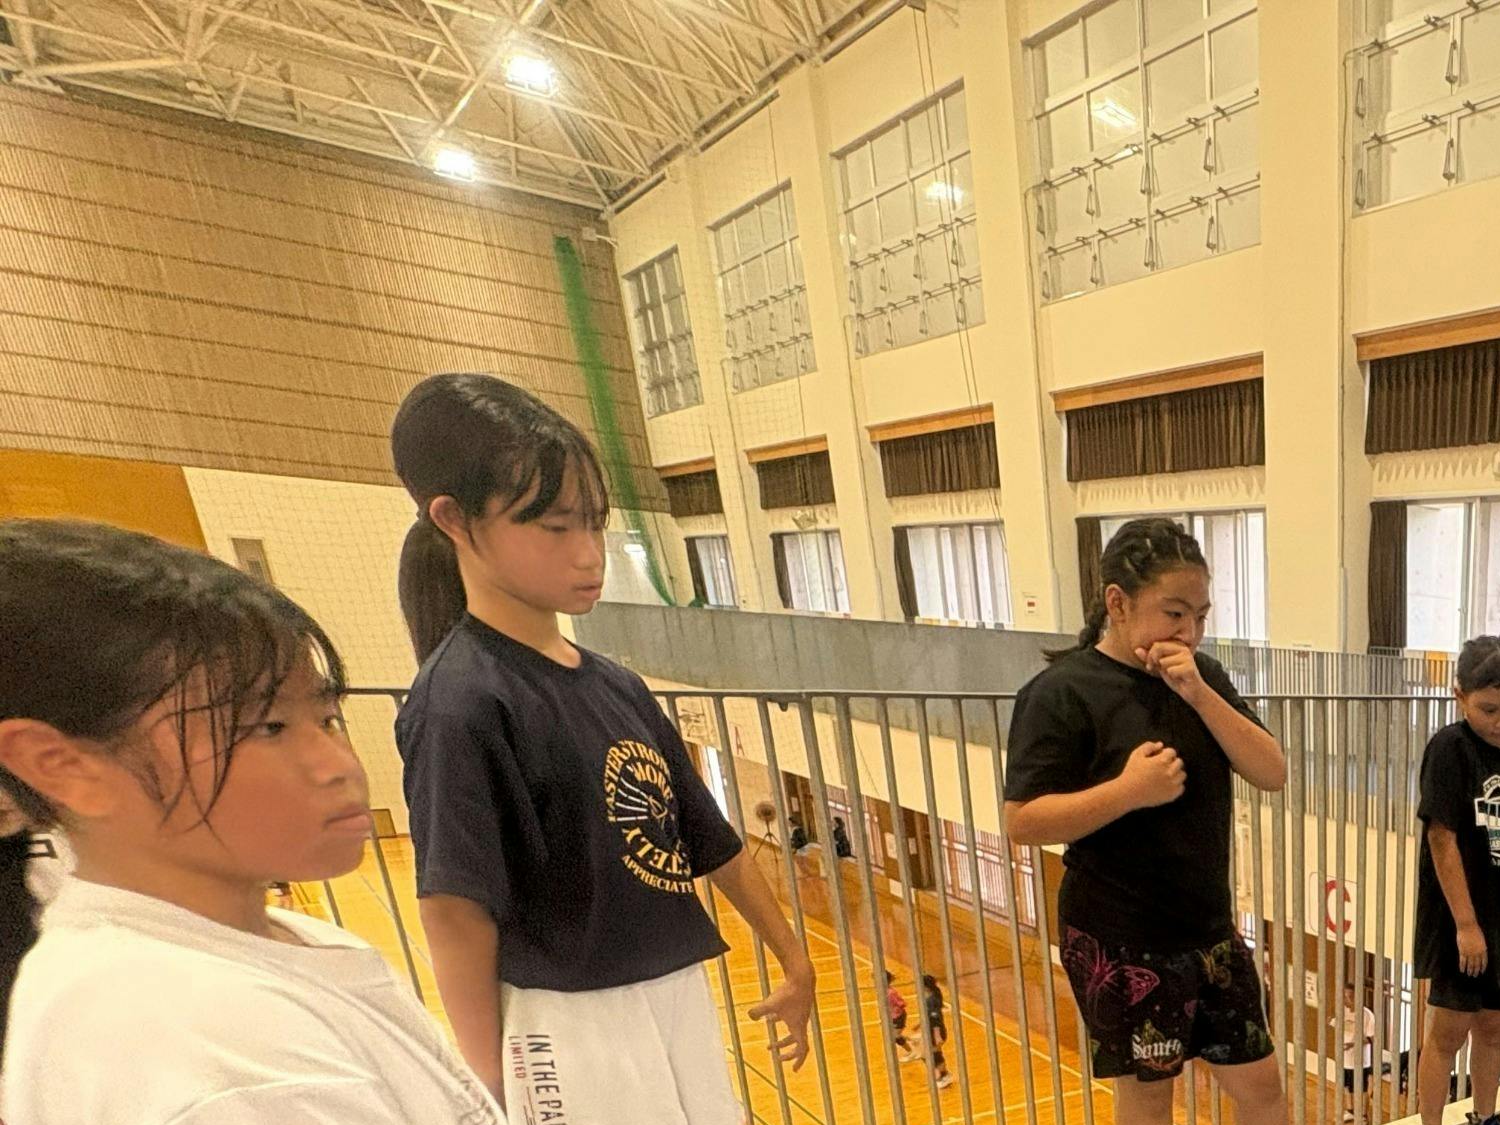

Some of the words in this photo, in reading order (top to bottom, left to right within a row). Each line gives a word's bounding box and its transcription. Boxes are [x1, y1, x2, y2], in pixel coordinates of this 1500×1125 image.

[621, 853, 695, 893] APPRECIATE
[508, 1035, 527, 1079] LIMITED
[526, 1034, 553, 1053] IN
[531, 1060, 560, 1094] THE
